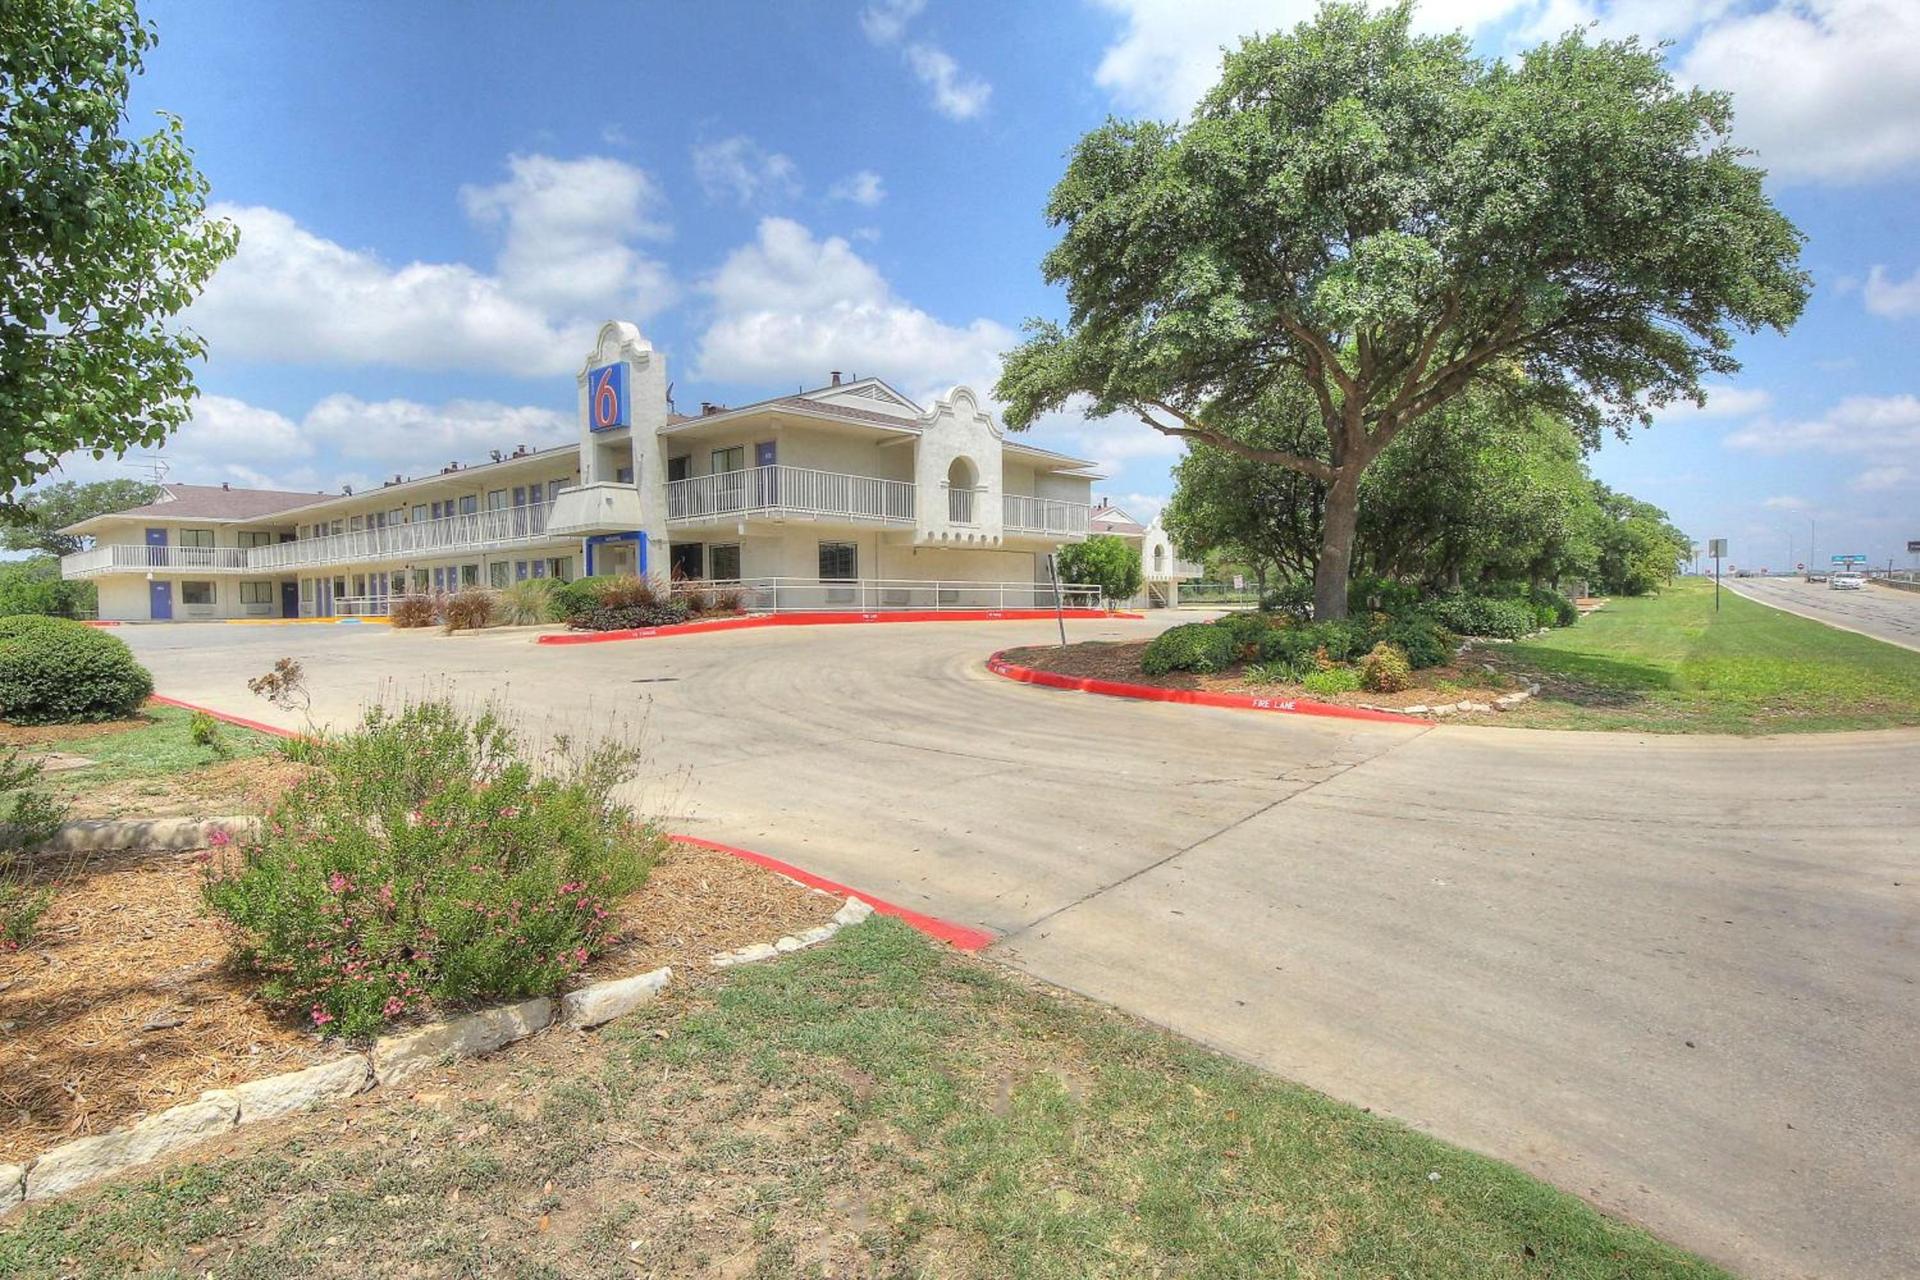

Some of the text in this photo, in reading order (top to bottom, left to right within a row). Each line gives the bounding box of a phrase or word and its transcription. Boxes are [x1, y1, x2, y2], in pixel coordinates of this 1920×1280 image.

[595, 367, 617, 427] 6
[1252, 699, 1296, 710] FIRE LANE
